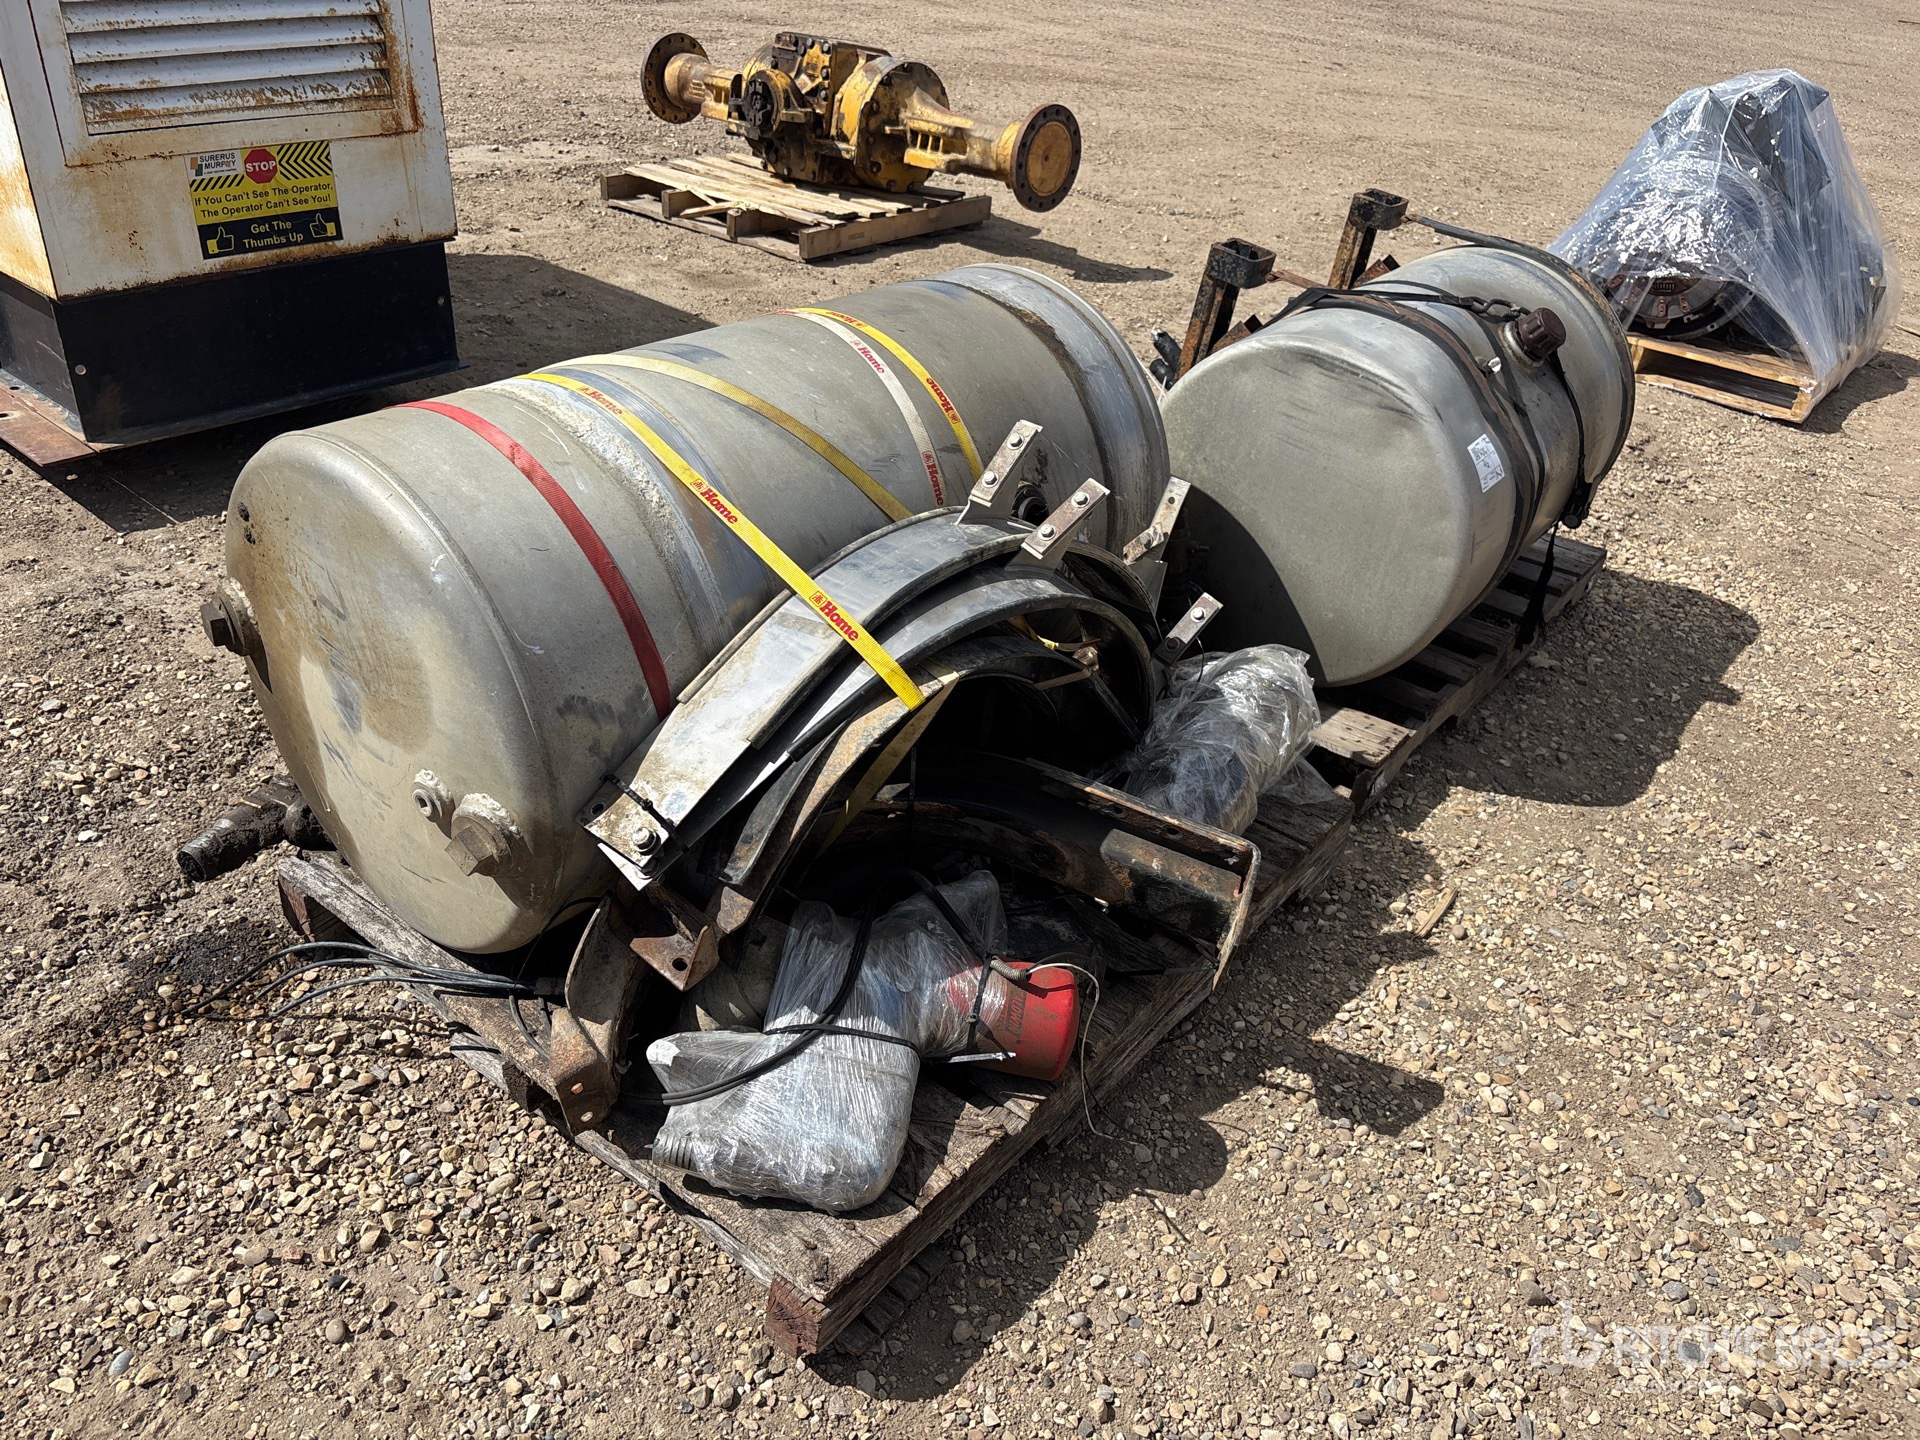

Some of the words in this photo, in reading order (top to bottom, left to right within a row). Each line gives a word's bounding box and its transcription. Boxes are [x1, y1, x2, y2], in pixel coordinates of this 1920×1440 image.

[199, 152, 236, 163] SURERUS
[204, 160, 236, 170] MURPY
[245, 161, 276, 172] STOP
[194, 197, 202, 206] If
[203, 194, 222, 205] You
[224, 191, 250, 202] Can't
[252, 190, 270, 199] See
[272, 187, 290, 196] The
[291, 182, 334, 194] Operator,
[200, 208, 219, 218] The
[221, 203, 263, 217] Operator
[265, 199, 291, 210] Can't
[292, 196, 310, 206] See
[311, 193, 331, 203] You!
[250, 222, 269, 234] Get
[271, 220, 292, 231] The
[242, 234, 287, 249] Thumbs
[288, 231, 304, 244] Up
[858, 346, 885, 374] Home
[926, 377, 954, 414] Home
[925, 462, 944, 507] Home
[699, 487, 738, 525] Home
[819, 600, 859, 641] Home
